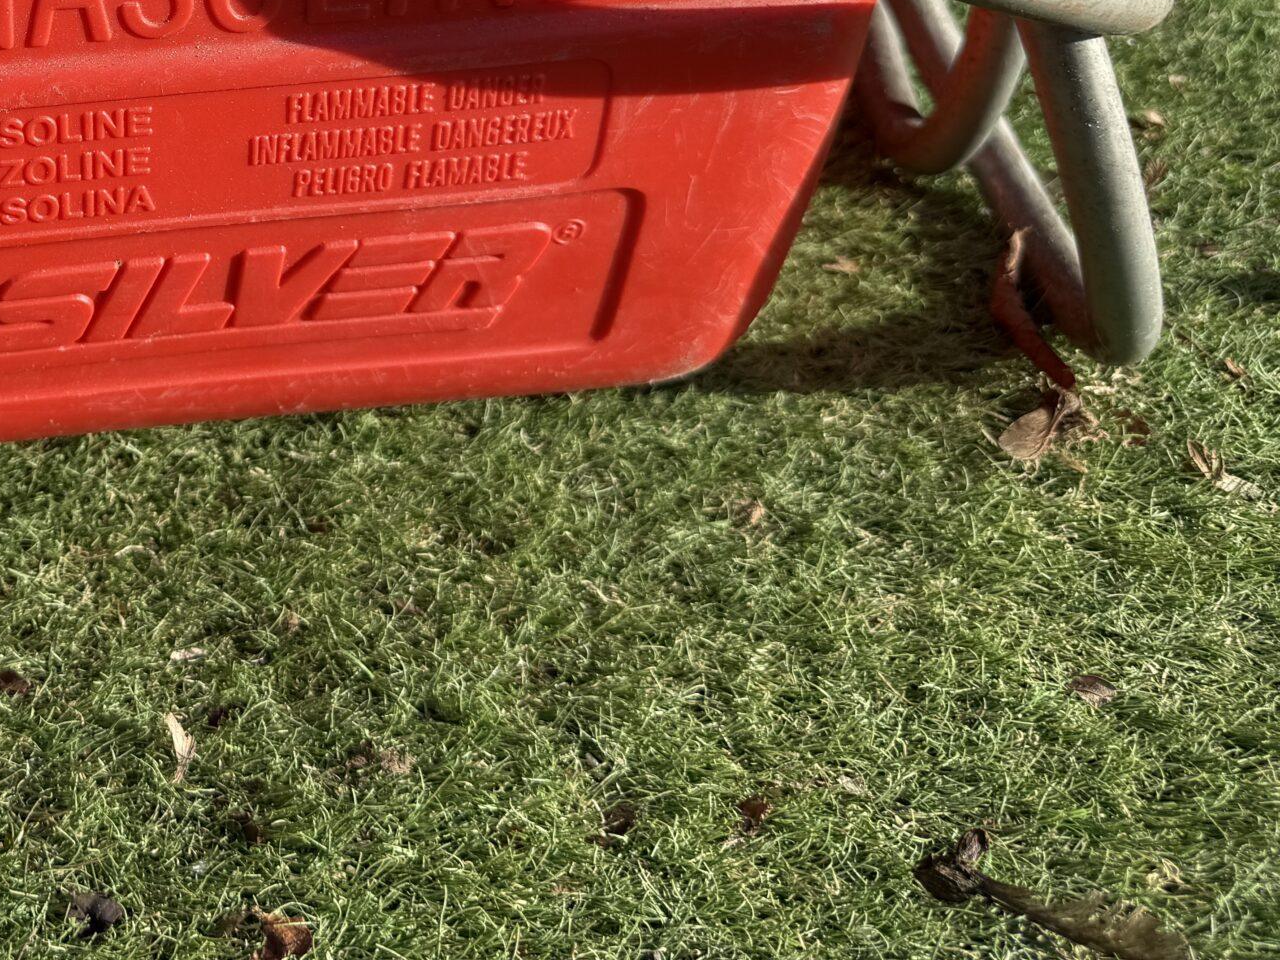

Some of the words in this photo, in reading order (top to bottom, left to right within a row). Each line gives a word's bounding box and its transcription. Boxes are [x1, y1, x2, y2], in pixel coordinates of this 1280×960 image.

[286, 82, 436, 124] FLAMMABLE
[445, 73, 547, 111] DANGER
[248, 123, 422, 166] INFLAMMABLE
[431, 108, 578, 152] DANGEREUX
[292, 162, 394, 198] PELIGRO
[404, 150, 530, 190] FLAMABLE
